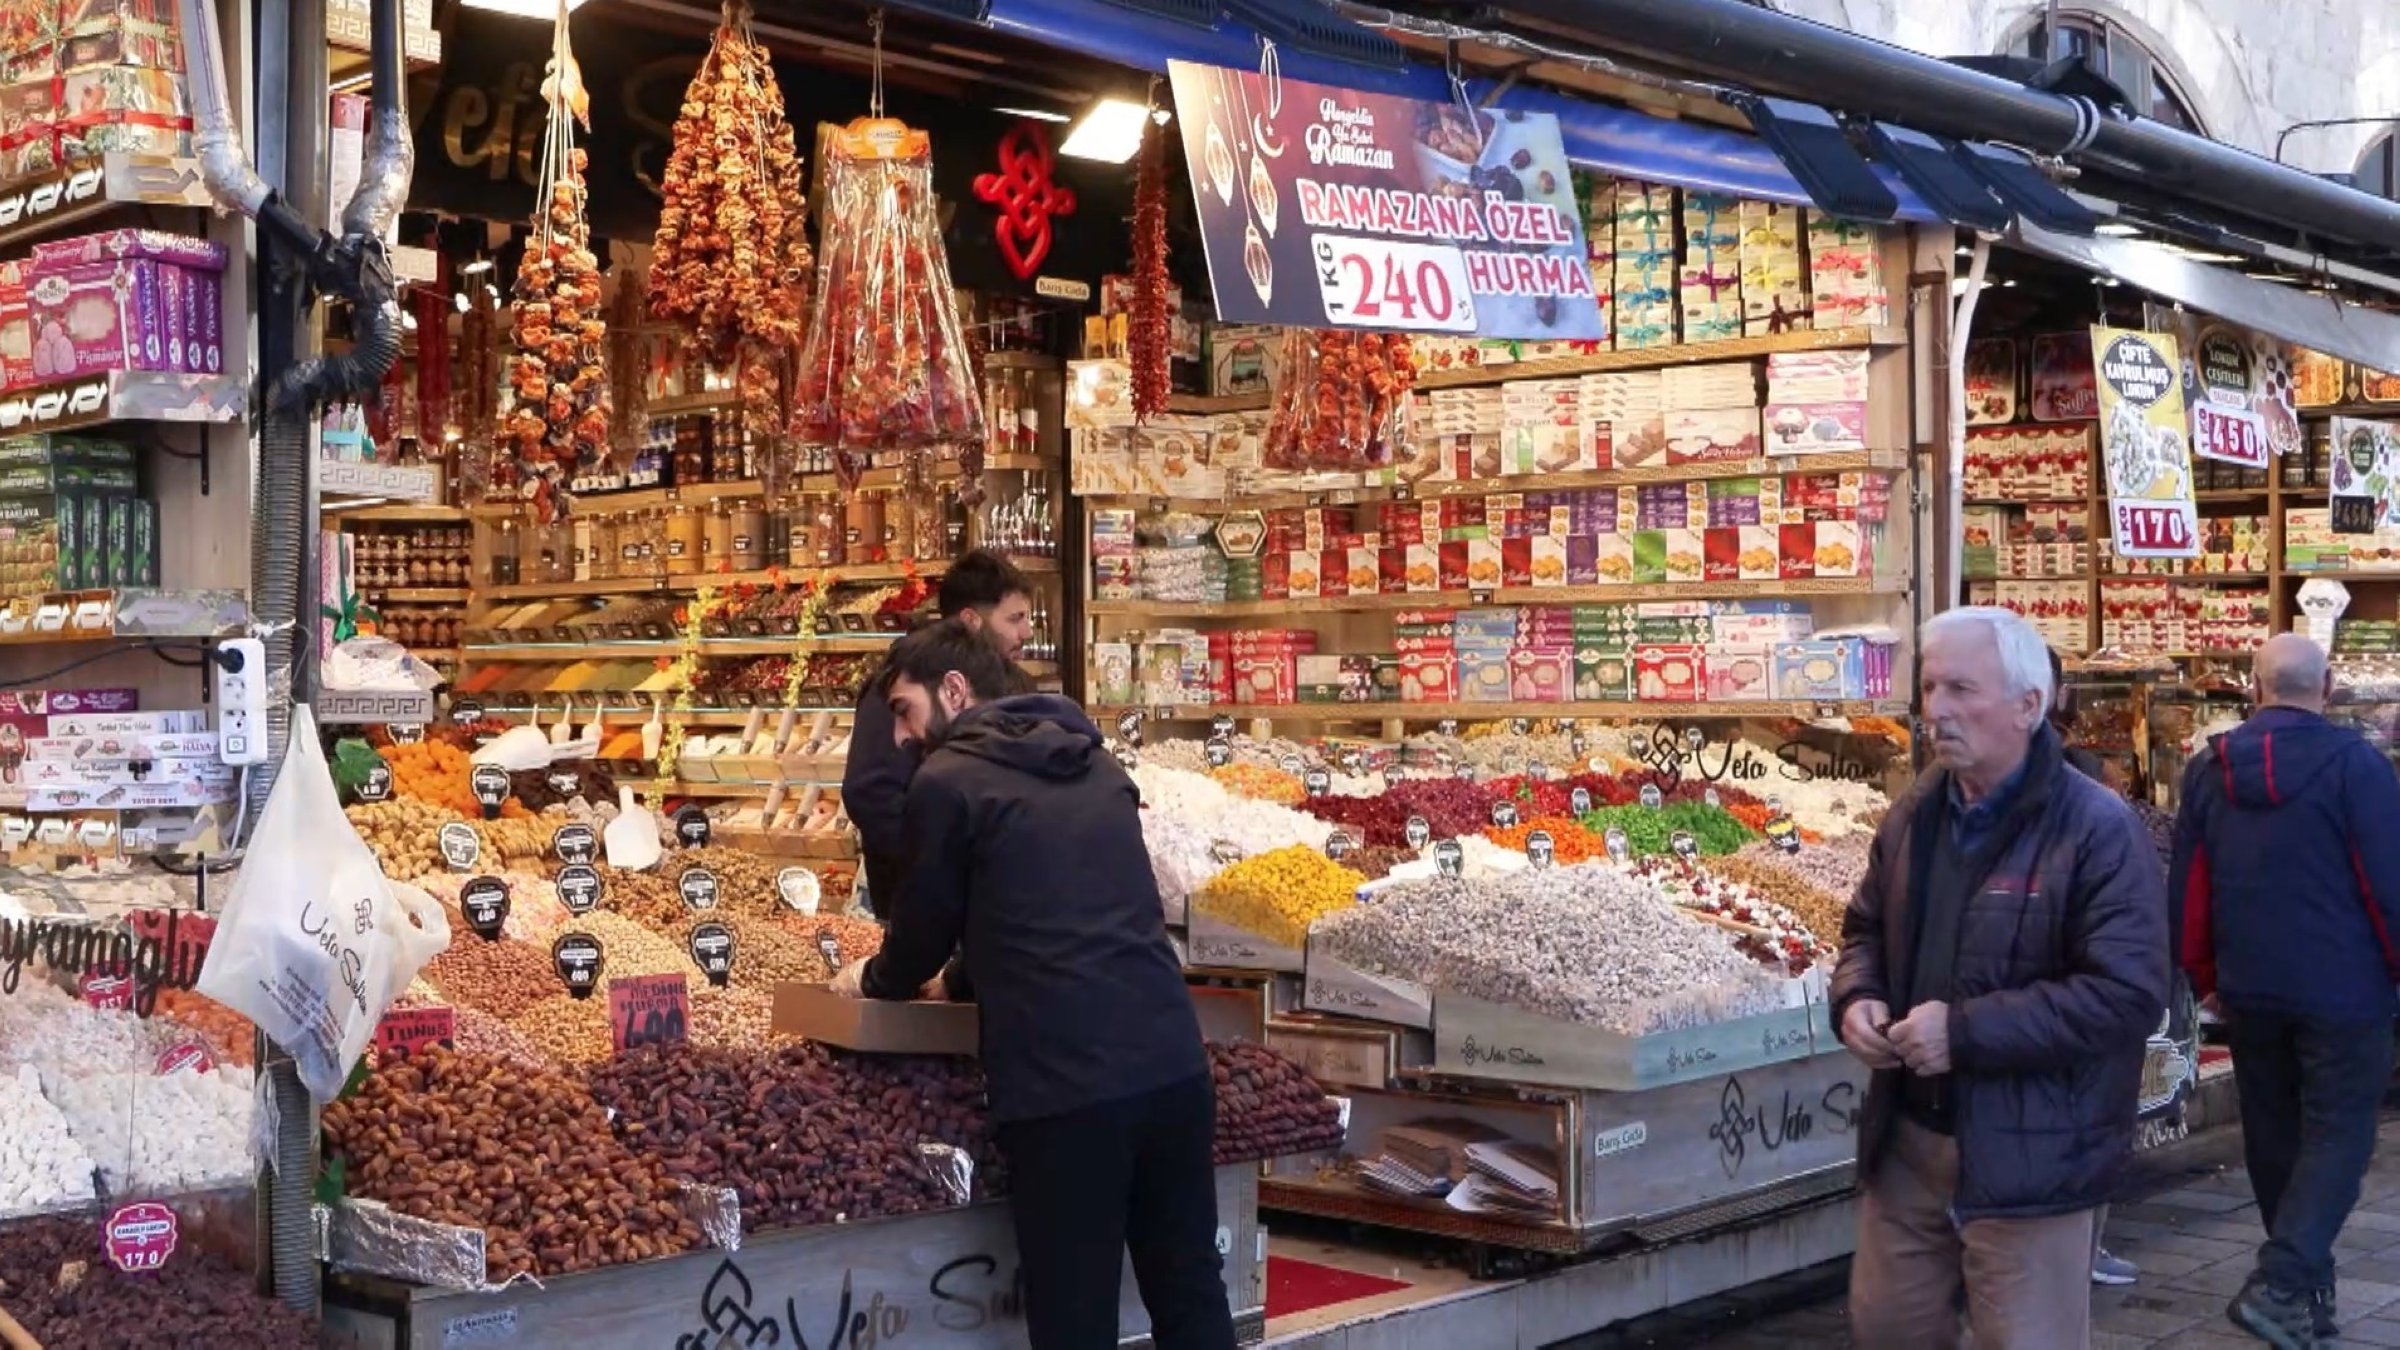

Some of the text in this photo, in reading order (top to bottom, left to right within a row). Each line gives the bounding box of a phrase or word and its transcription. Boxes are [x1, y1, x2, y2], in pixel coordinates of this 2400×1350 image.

[1305, 123, 1394, 169] Ramazan
[1297, 181, 1572, 244] RAMAZANA ÖZEL
[1317, 241, 1339, 287] KG
[1341, 251, 1453, 321] 240
[1465, 251, 1594, 297] HURMA
[2105, 361, 2169, 388] KAVRULMUŞ
[2120, 341, 2151, 364] ÇİFTE
[2122, 382, 2156, 399] LOKUM
[2213, 416, 2255, 456] 450
[2134, 510, 2184, 543] 170
[1696, 738, 1880, 782] Vefa Sultan
[300, 900, 339, 959] Vefa
[623, 1005, 685, 1049] 600
[1758, 1089, 1813, 1151] Vefa
[124, 1245, 159, 1268] 170
[787, 1267, 909, 1350] Vefa
